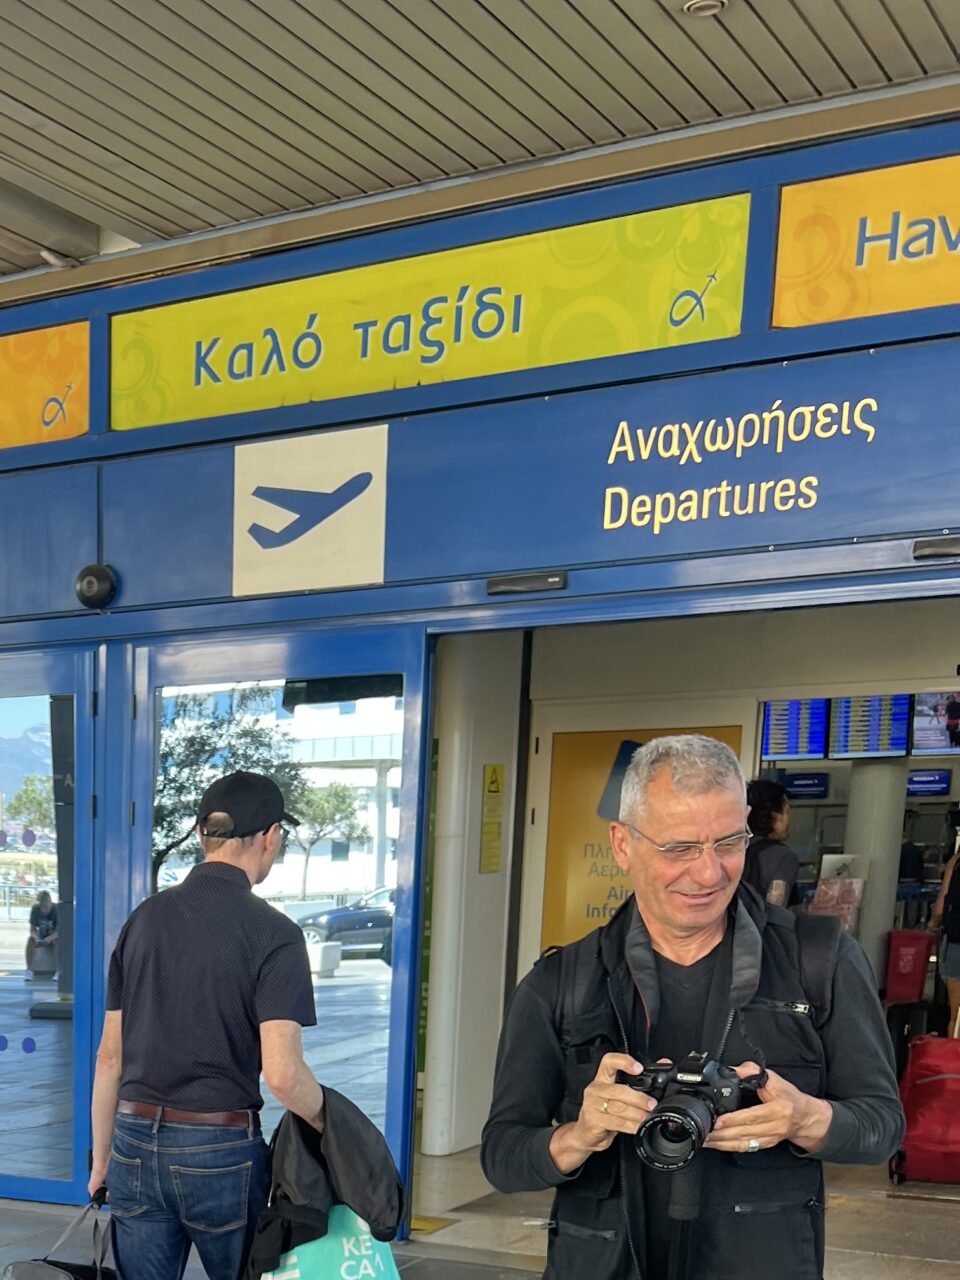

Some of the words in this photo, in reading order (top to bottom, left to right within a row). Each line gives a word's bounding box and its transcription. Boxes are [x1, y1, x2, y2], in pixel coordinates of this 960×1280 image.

[194, 313, 323, 388] Καλό
[352, 284, 523, 364] ταξίδι
[606, 397, 878, 466] Αναχωρήσεις
[603, 475, 819, 535] Departures
[676, 1073, 703, 1082] Canon
